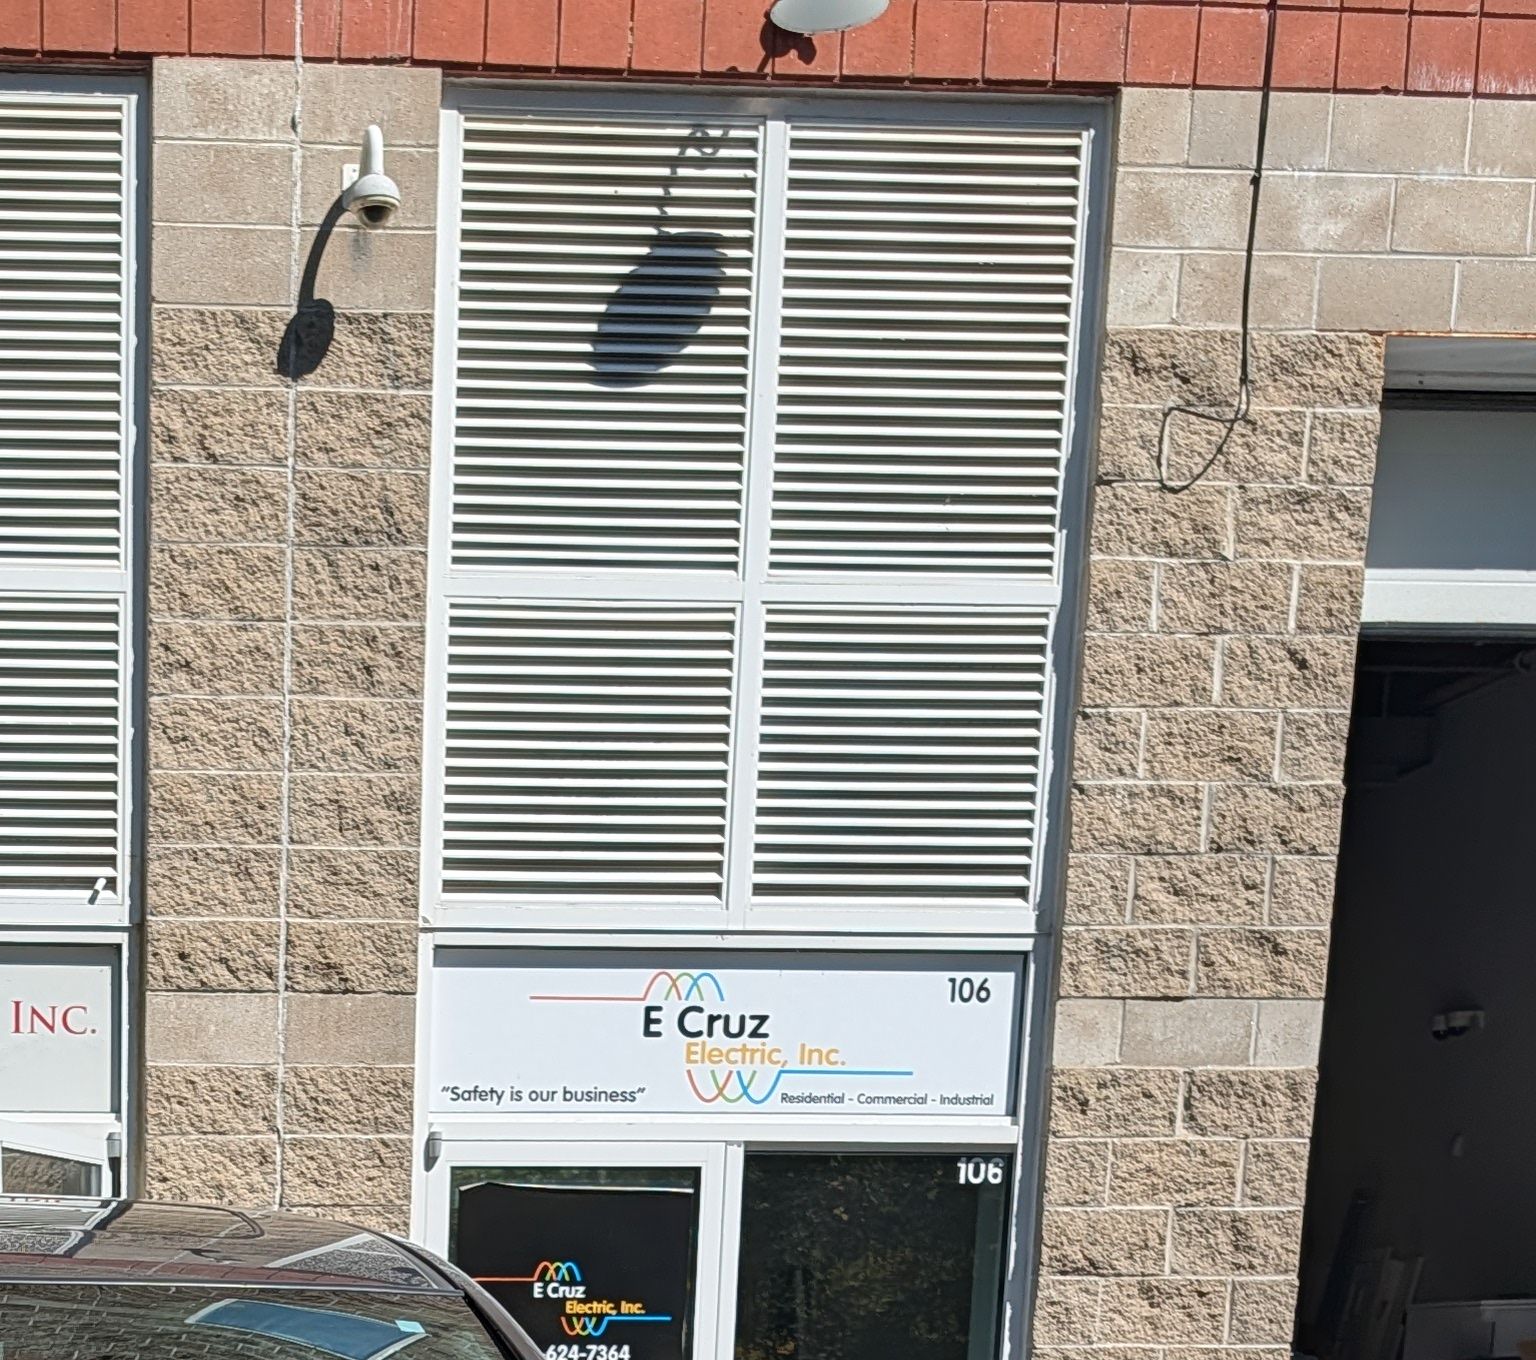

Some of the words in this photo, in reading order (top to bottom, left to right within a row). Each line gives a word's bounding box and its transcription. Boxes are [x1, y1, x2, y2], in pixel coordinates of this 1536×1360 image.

[947, 976, 991, 1004] 106
[642, 1005, 664, 1038] E
[677, 1005, 770, 1039] Cruz
[685, 1040, 789, 1068] Electric,
[798, 1042, 847, 1066] Inc.
[509, 1085, 524, 1102] is
[528, 1088, 558, 1102] our
[780, 1092, 845, 1105] Residential
[857, 1092, 928, 1106] Commercial
[939, 1093, 995, 1106] Industrial
[956, 1156, 1004, 1185] 106
[533, 1282, 544, 1298] E
[546, 1282, 586, 1298] Cruz
[565, 1300, 618, 1315] Electric,
[620, 1300, 646, 1314] Inc.
